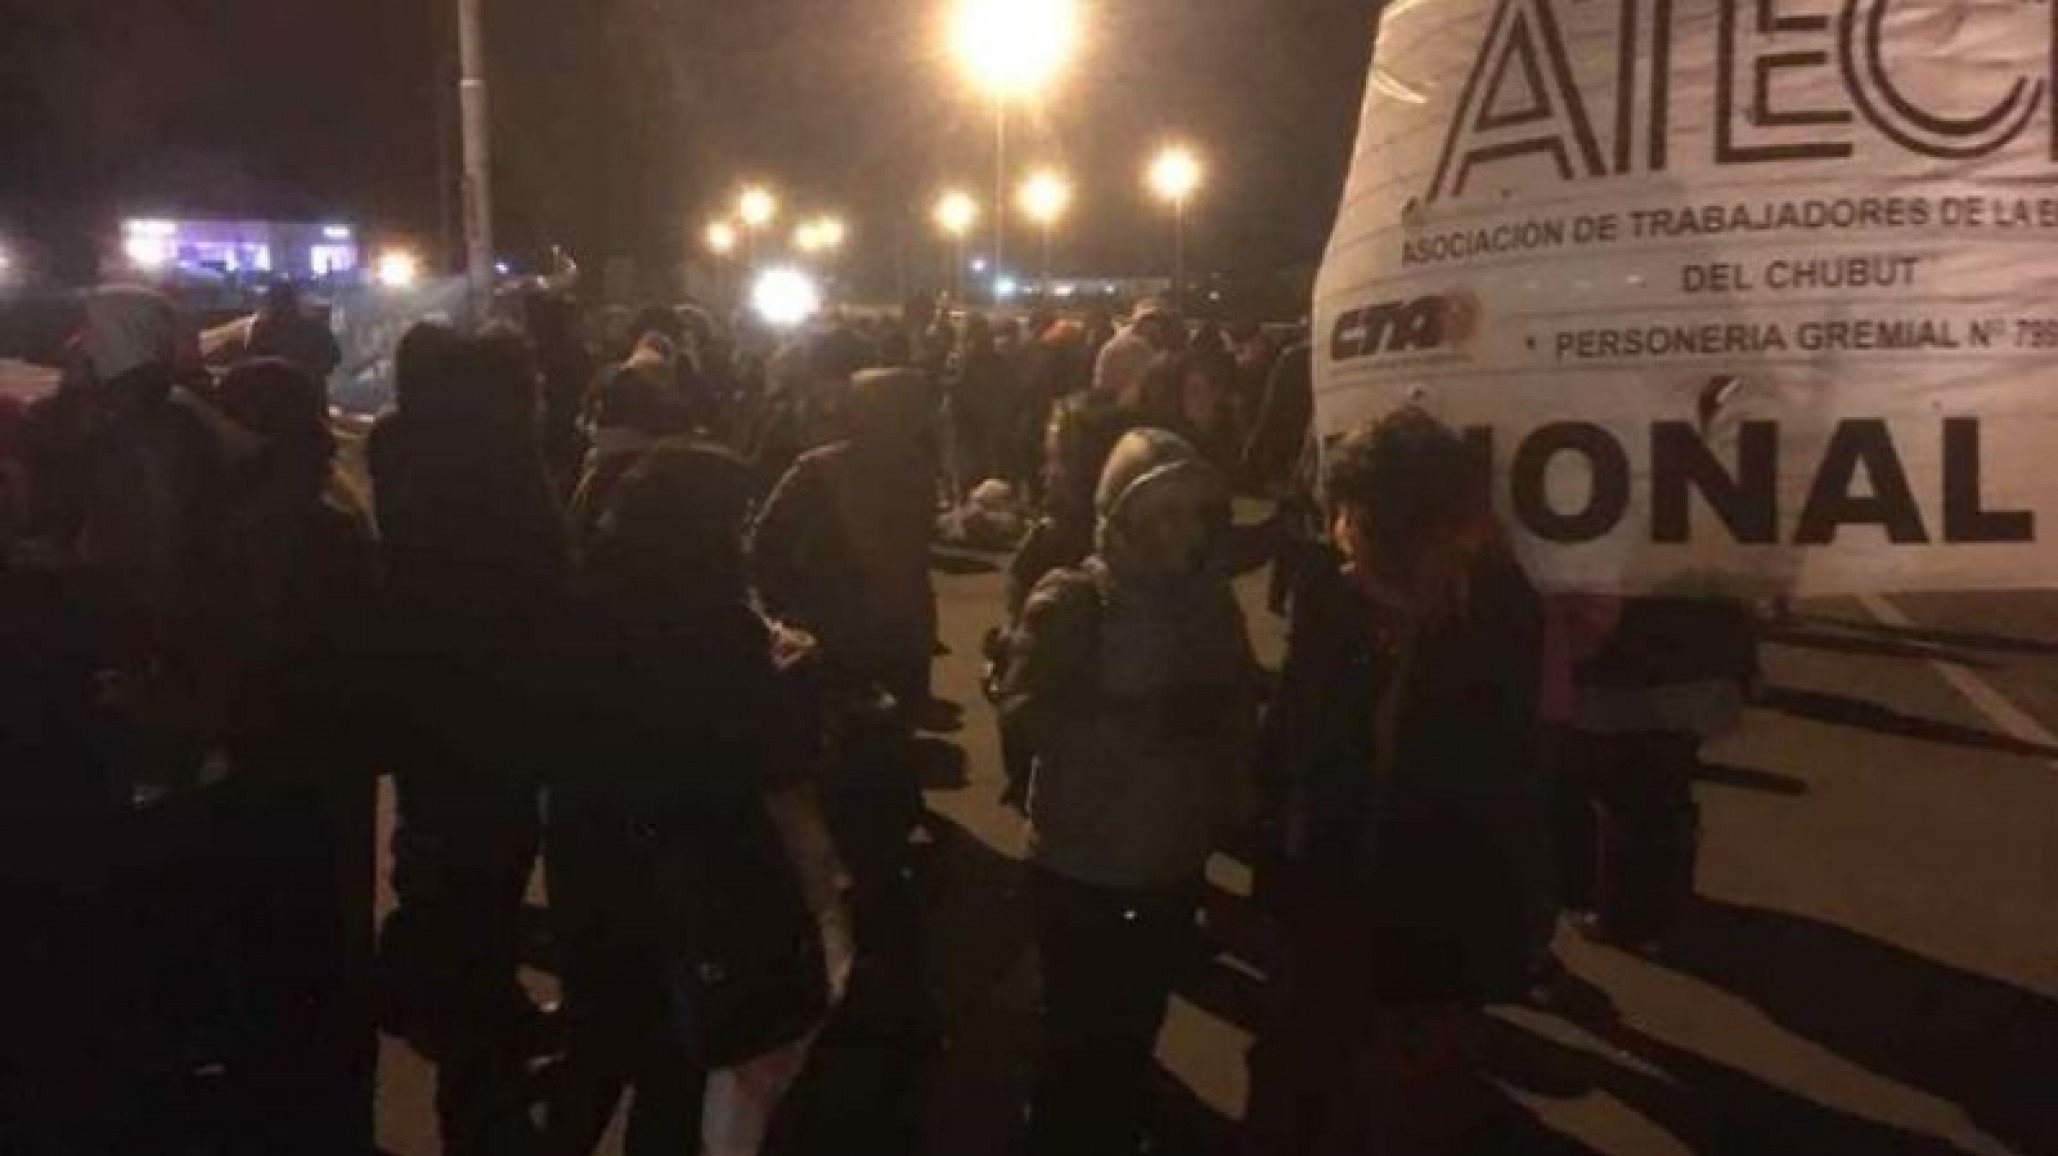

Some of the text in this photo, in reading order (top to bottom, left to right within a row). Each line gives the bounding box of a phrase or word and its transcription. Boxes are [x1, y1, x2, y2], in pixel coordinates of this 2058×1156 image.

[1427, 0, 2058, 203] ATEC
[1573, 213, 1617, 244] DE
[1627, 197, 1929, 238] TRABAJADORES
[1941, 195, 1985, 227] DE
[1994, 198, 2029, 227] LA
[1682, 255, 1919, 293] DEL CHUBUT
[1556, 322, 1787, 360] PERSONERIA
[1798, 319, 1961, 351] GREMIAL
